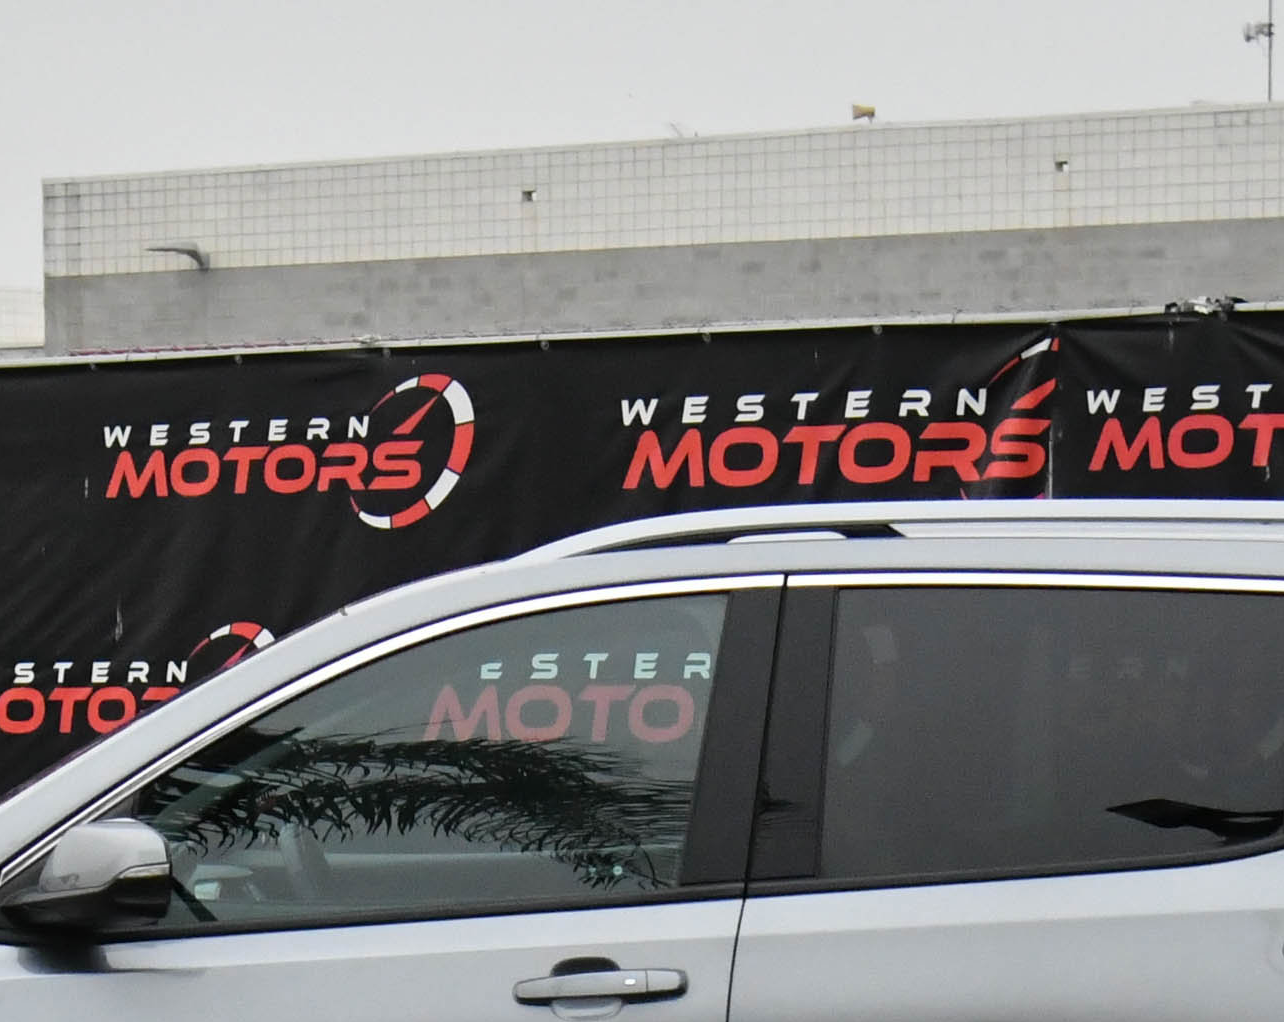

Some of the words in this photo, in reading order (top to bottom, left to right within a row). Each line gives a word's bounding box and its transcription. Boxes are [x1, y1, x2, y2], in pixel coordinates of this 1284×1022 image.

[103, 415, 370, 449] WESTERN
[621, 388, 987, 427] WESTERN
[105, 439, 425, 500] MOTORS
[622, 417, 1052, 491] MOTORS
[421, 684, 695, 743] MOTO
